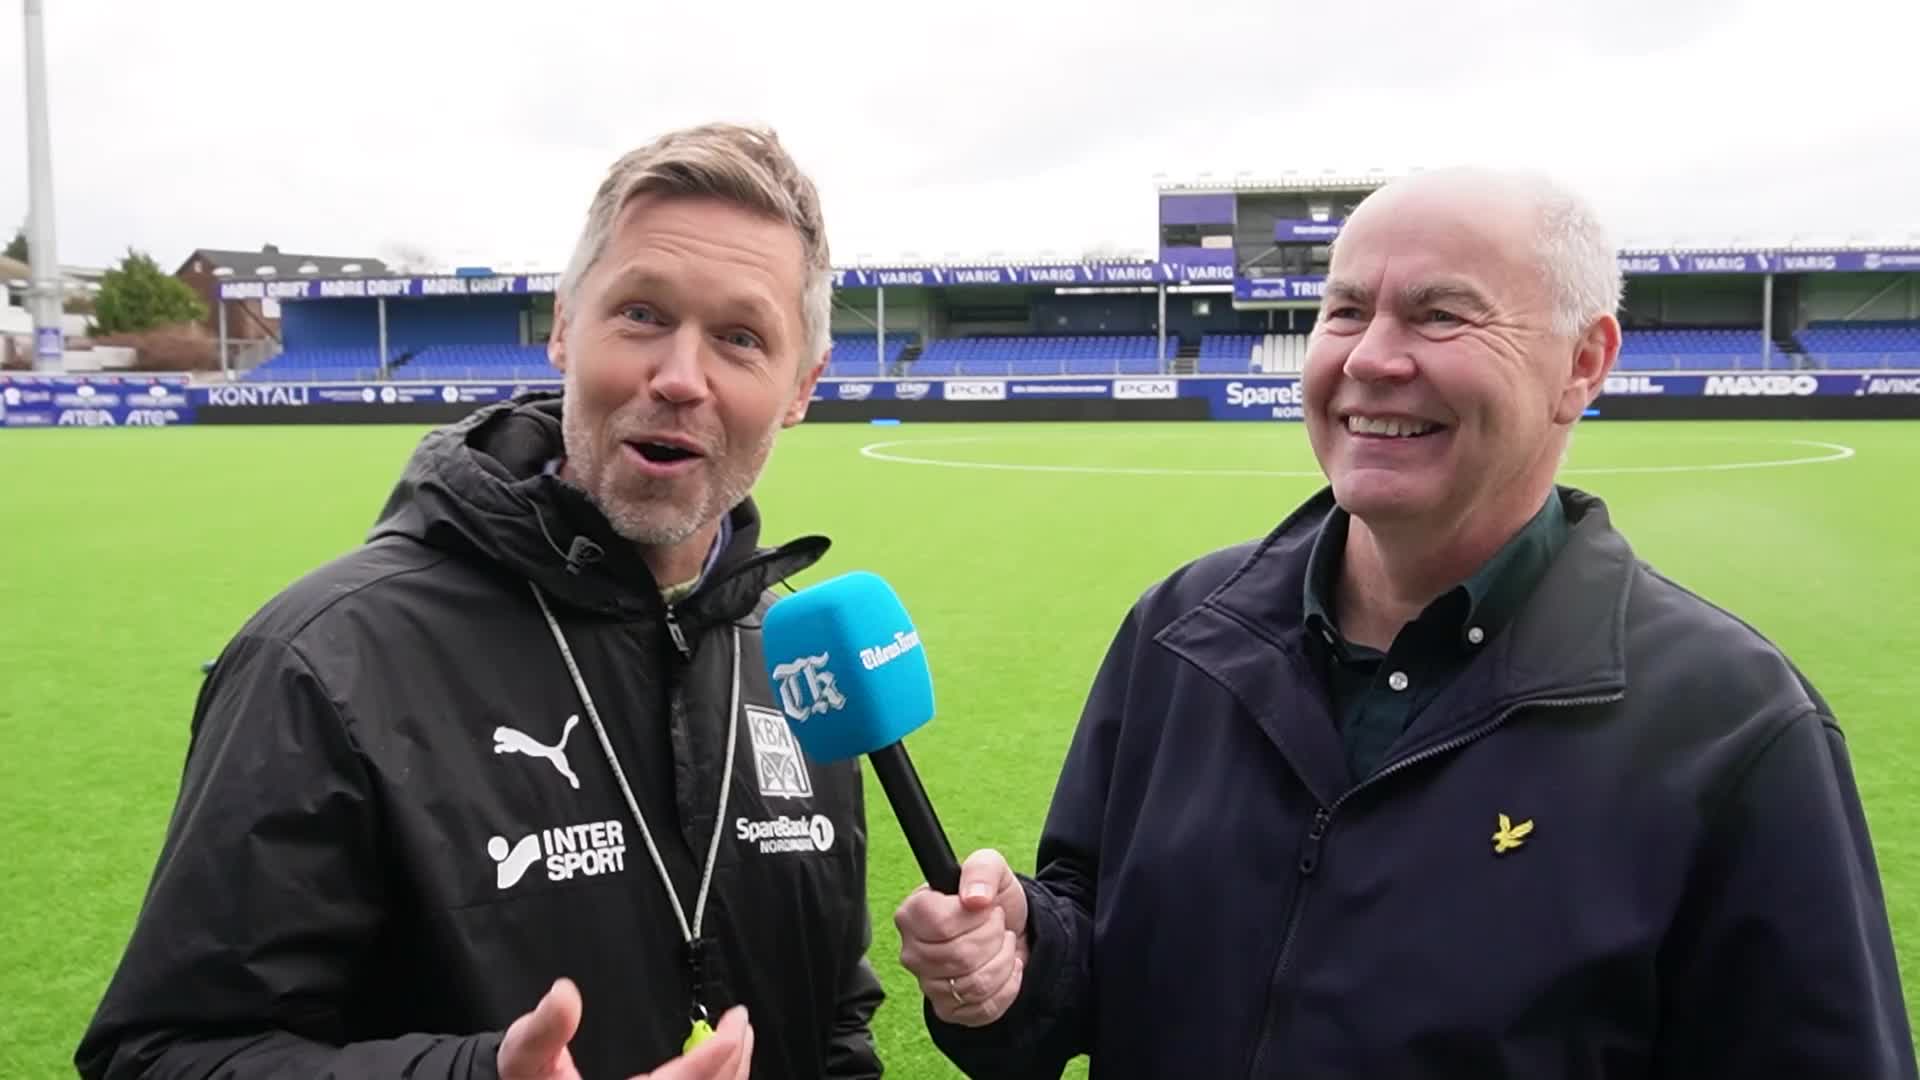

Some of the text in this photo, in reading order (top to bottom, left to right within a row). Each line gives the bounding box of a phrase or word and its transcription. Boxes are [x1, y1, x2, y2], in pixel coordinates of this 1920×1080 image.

[1618, 257, 1660, 271] ARIG
[1695, 256, 1745, 271] VARIG
[1784, 255, 1836, 270] VARIG
[879, 270, 923, 285] VARIG
[955, 269, 1000, 283] VARIG
[1030, 268, 1075, 282] VARIG
[1105, 267, 1152, 281] VARIG
[1187, 266, 1233, 280] VARIG
[950, 384, 998, 395] PCM
[1120, 383, 1171, 394] PCM
[1704, 376, 1819, 396] MAXBO
[208, 387, 310, 406] KONTALI
[736, 814, 810, 843] SpareBank
[543, 819, 625, 856] INTER
[546, 845, 627, 882] SPORT
